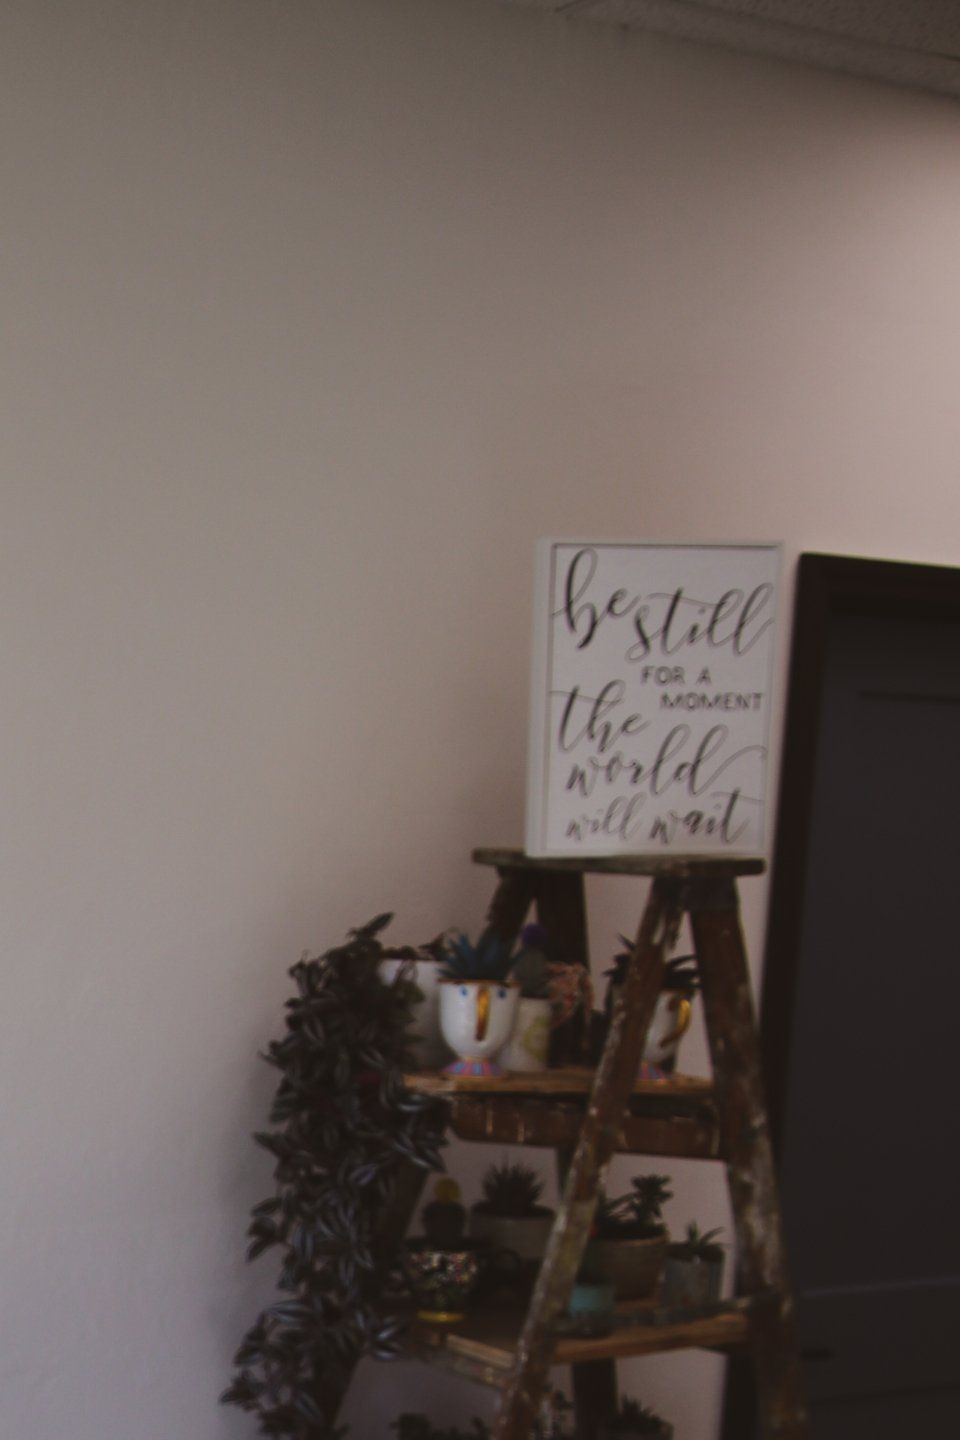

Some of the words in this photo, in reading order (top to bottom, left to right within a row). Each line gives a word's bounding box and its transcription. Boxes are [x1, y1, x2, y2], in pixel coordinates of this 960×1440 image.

[552, 548, 640, 650] be
[625, 582, 774, 662] still
[641, 665, 686, 684] FOR
[698, 666, 712, 684] A
[659, 692, 763, 712] MOMENT
[550, 679, 650, 753] the
[565, 724, 768, 796] world
[565, 791, 642, 841] will
[648, 786, 764, 845] wait
